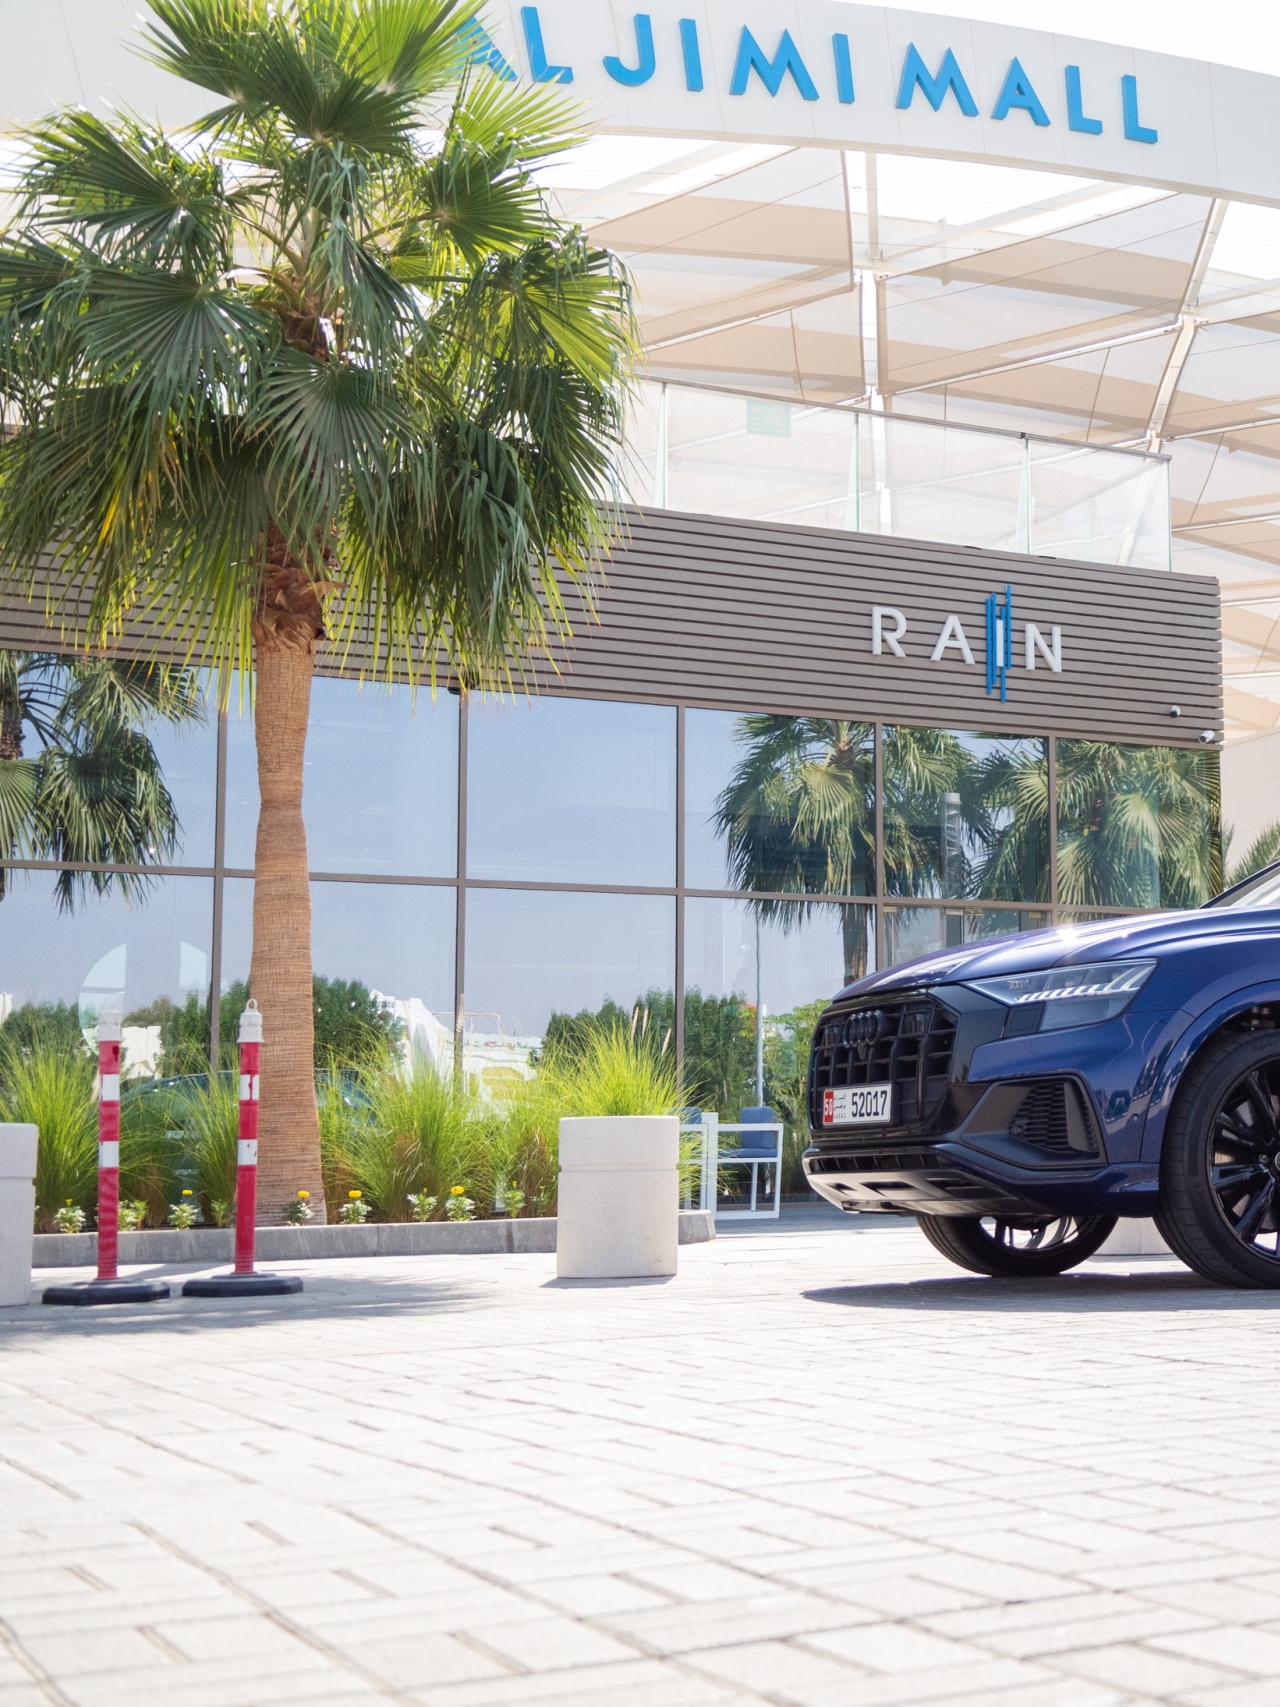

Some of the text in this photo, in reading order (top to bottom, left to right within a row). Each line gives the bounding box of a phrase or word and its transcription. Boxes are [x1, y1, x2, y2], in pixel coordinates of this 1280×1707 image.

[603, 14, 855, 104] JIMI
[895, 42, 1158, 144] MALL
[871, 605, 1063, 673] RAIN
[852, 1090, 888, 1117] 52017
